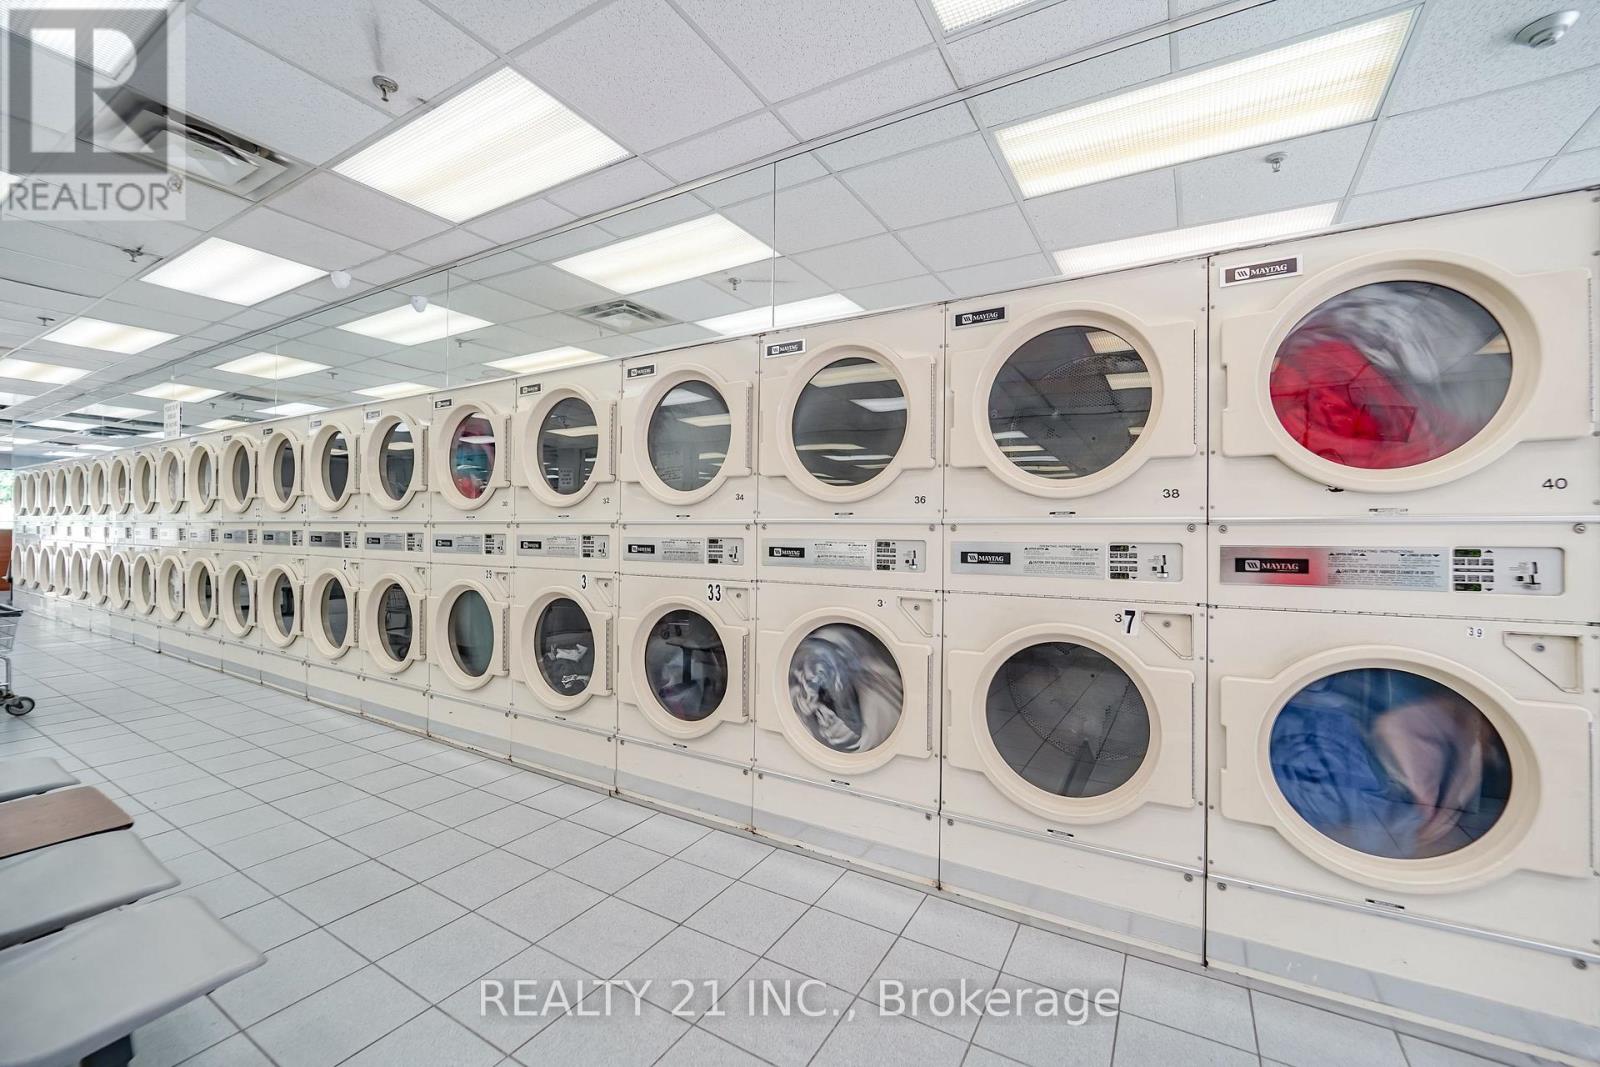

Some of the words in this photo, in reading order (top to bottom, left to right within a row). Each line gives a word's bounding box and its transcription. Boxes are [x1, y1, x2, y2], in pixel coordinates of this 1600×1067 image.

[1250, 263, 1288, 276] MAYTAG
[972, 312, 998, 321] MAYTAG
[1542, 478, 1568, 490] 40
[735, 493, 744, 501] 34
[1162, 488, 1180, 499] 38
[914, 495, 926, 504] 36
[978, 553, 1004, 562] MAYTAG
[1261, 562, 1299, 571] MAYTAG
[707, 584, 721, 601] 33
[1467, 627, 1483, 639] 39
